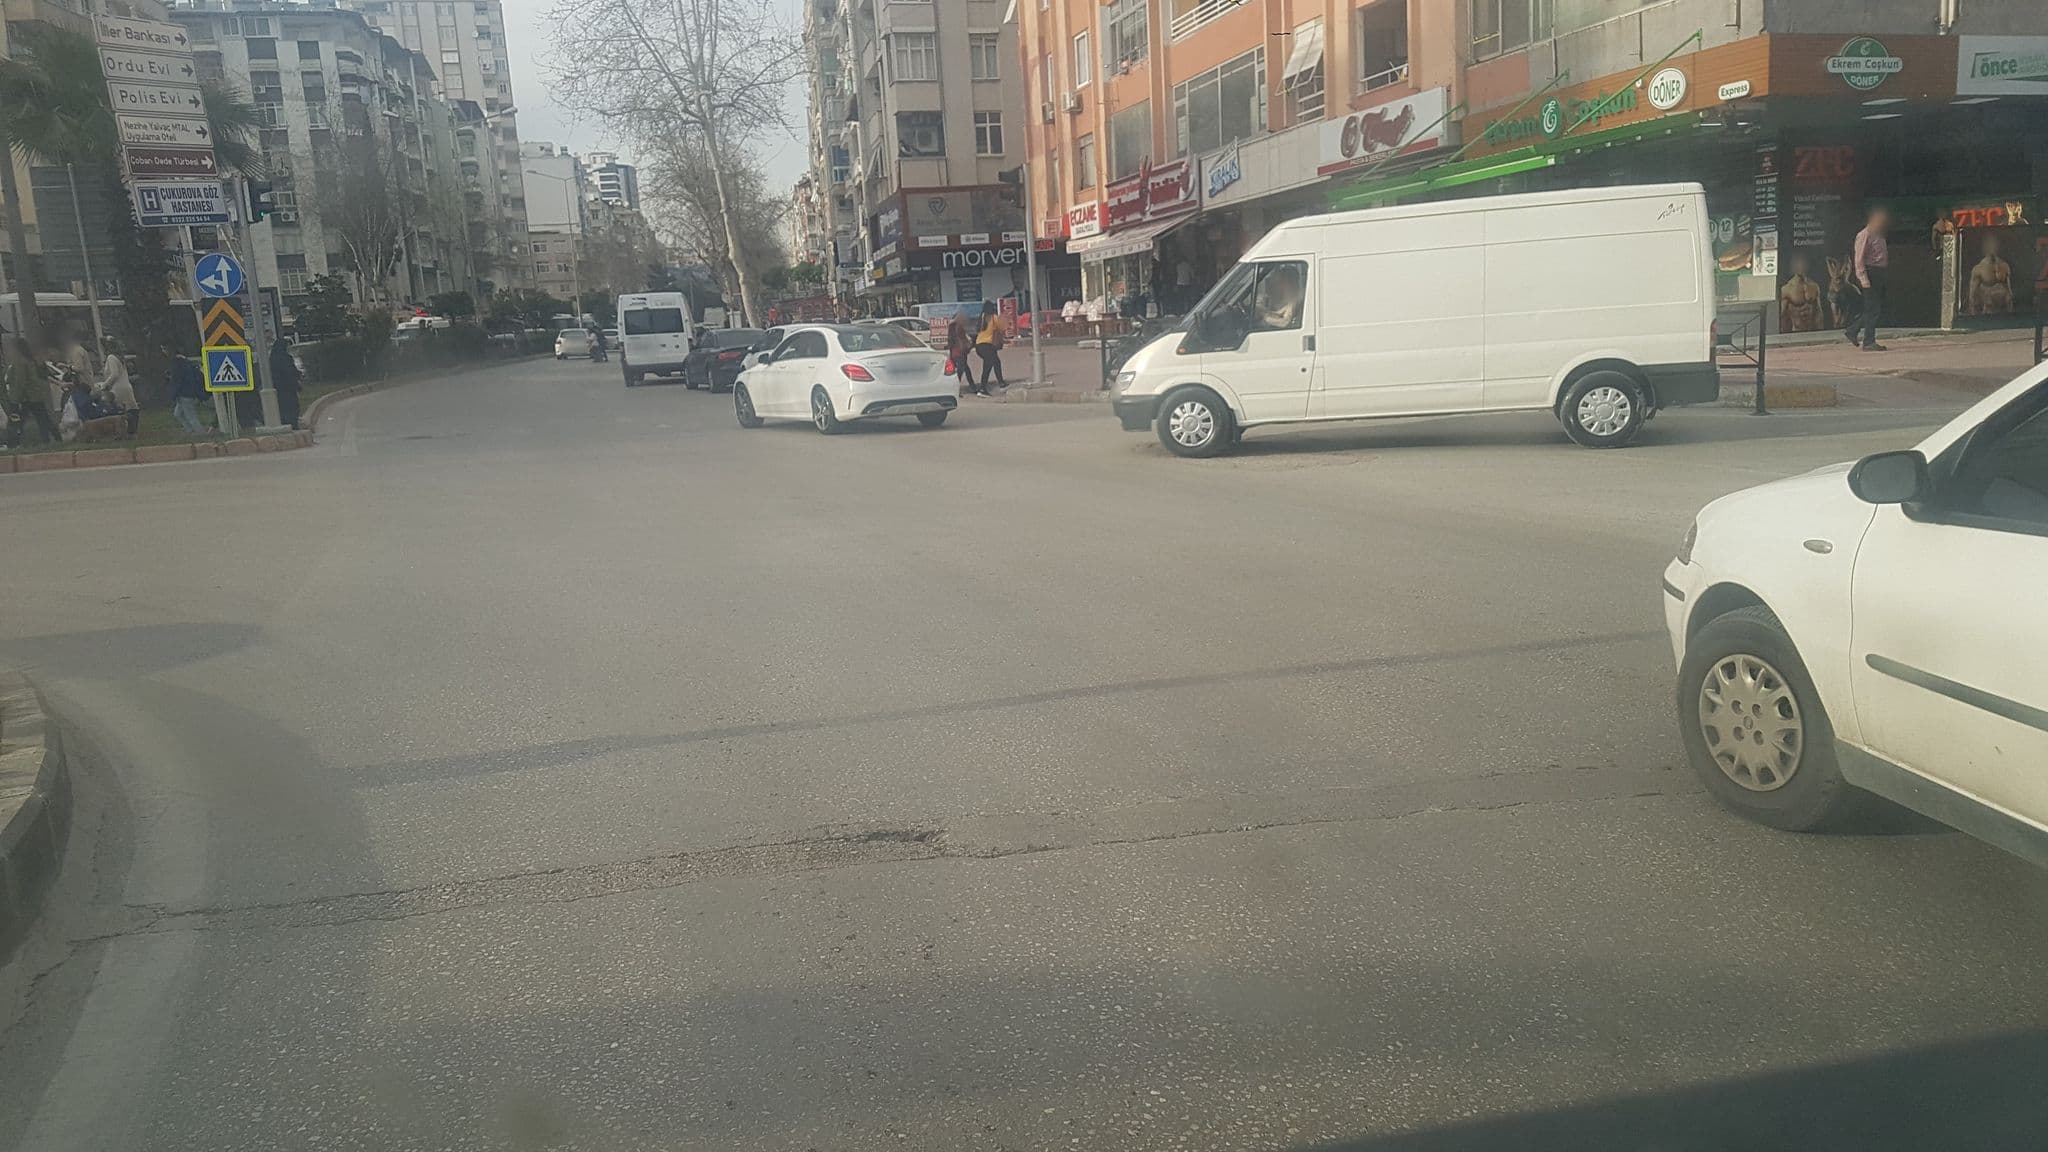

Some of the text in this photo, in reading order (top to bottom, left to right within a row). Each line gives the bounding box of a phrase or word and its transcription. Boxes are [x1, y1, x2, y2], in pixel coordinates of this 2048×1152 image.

[124, 26, 171, 44] Bankası
[106, 56, 170, 76] Ordu Evi
[1832, 58, 1900, 73] Ekrem Coşkun
[1980, 57, 2018, 78] önce
[119, 89, 182, 105] Polis Evi
[1653, 76, 1682, 103] DÖNER
[1720, 84, 1749, 98] Express
[160, 184, 220, 201] ÇUKUROVA GÖZ
[1070, 203, 1097, 227] ECZANE
